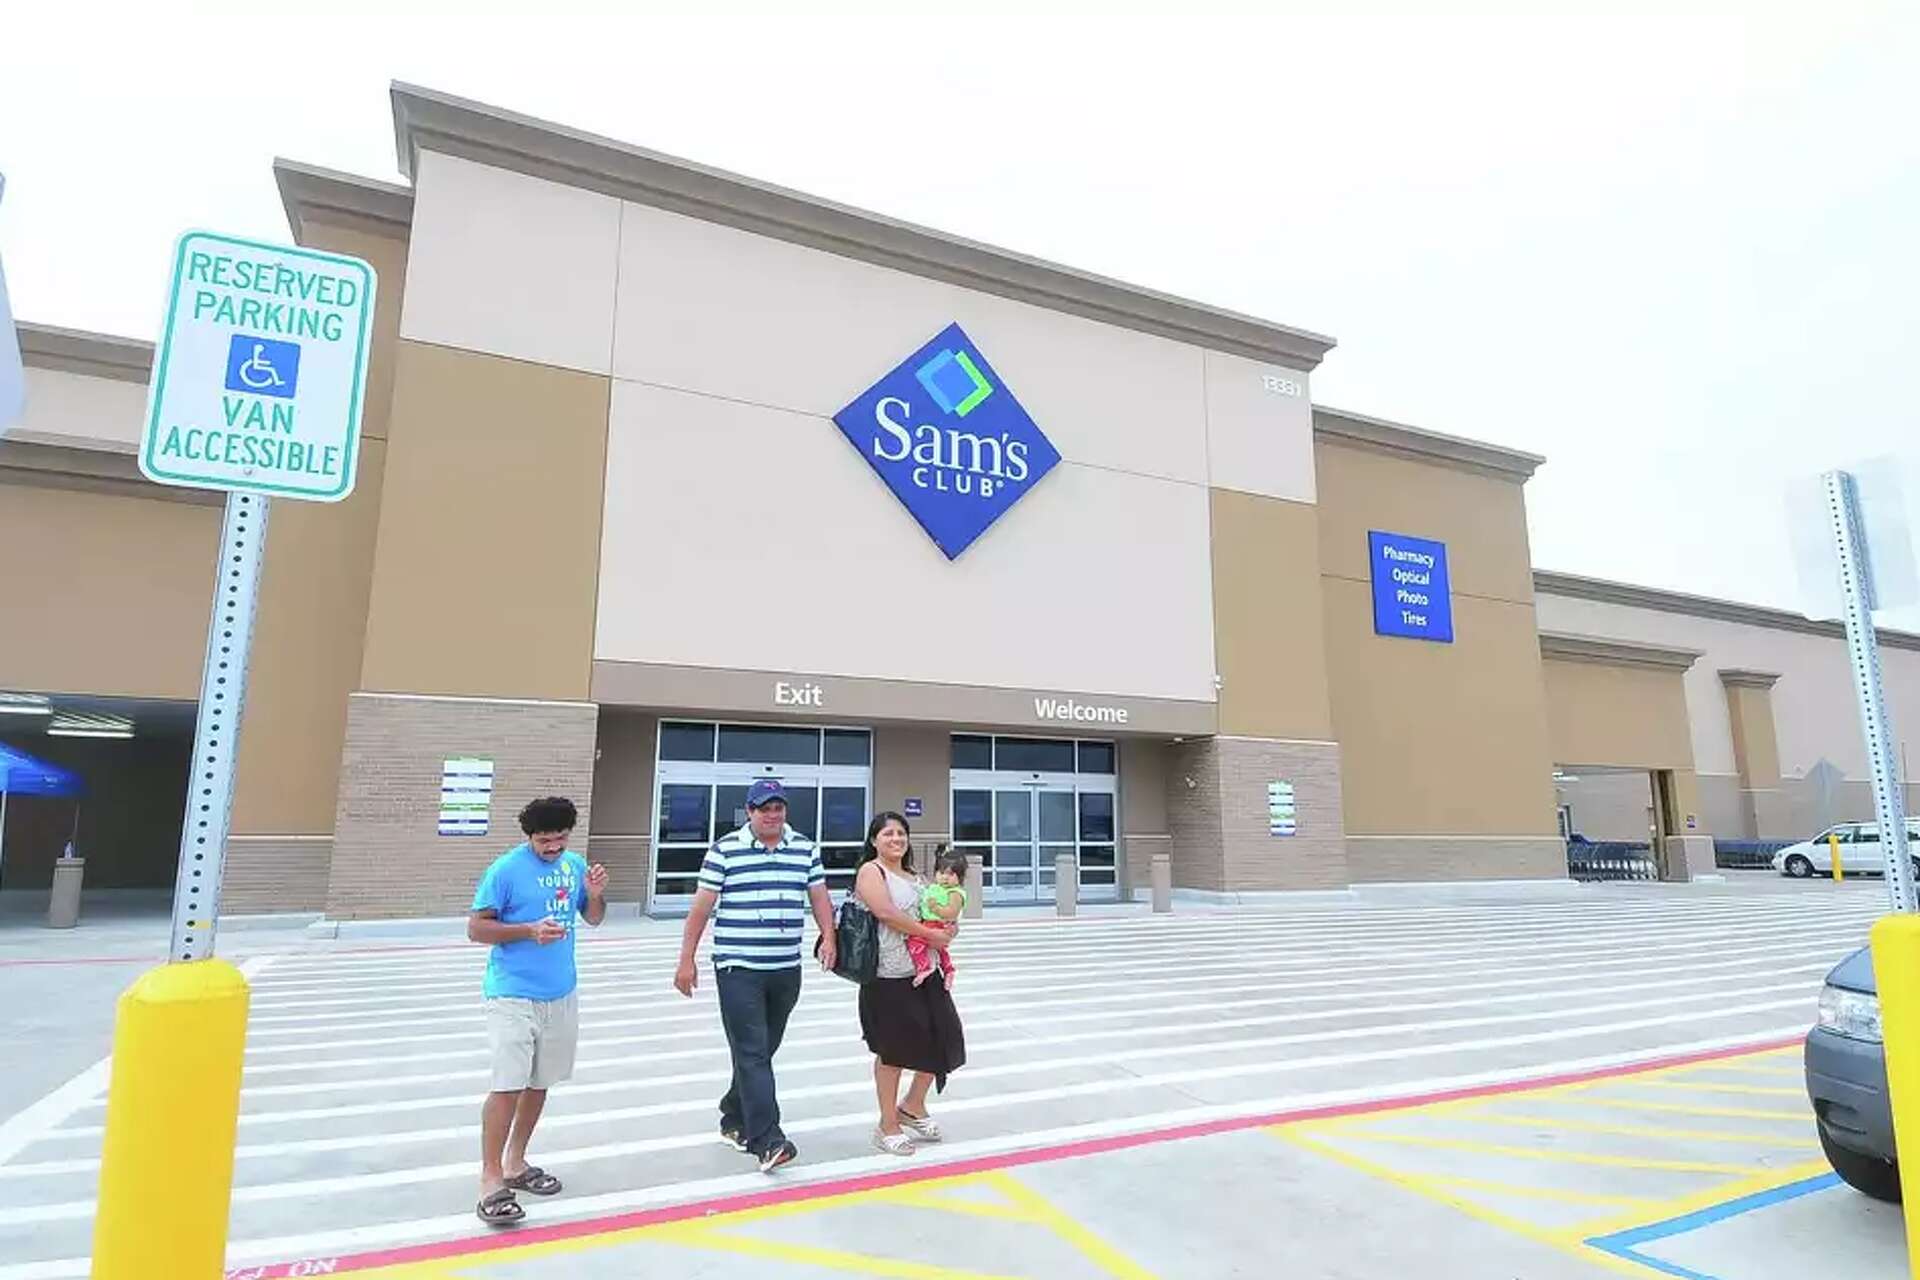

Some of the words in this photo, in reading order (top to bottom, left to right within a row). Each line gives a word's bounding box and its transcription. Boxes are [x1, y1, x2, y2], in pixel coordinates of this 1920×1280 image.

[188, 251, 357, 307] RESERVED
[194, 291, 343, 341] PARKING
[223, 396, 294, 434] VAN
[161, 425, 339, 475] ACCESSIBLE
[874, 397, 1028, 481] Sam's
[1383, 545, 1435, 569] Pharmacy
[1392, 568, 1430, 585] Optical
[1397, 590, 1429, 606] Photo
[1402, 610, 1427, 626] Tires
[776, 682, 823, 706] Exit
[1034, 698, 1128, 723] Welcome
